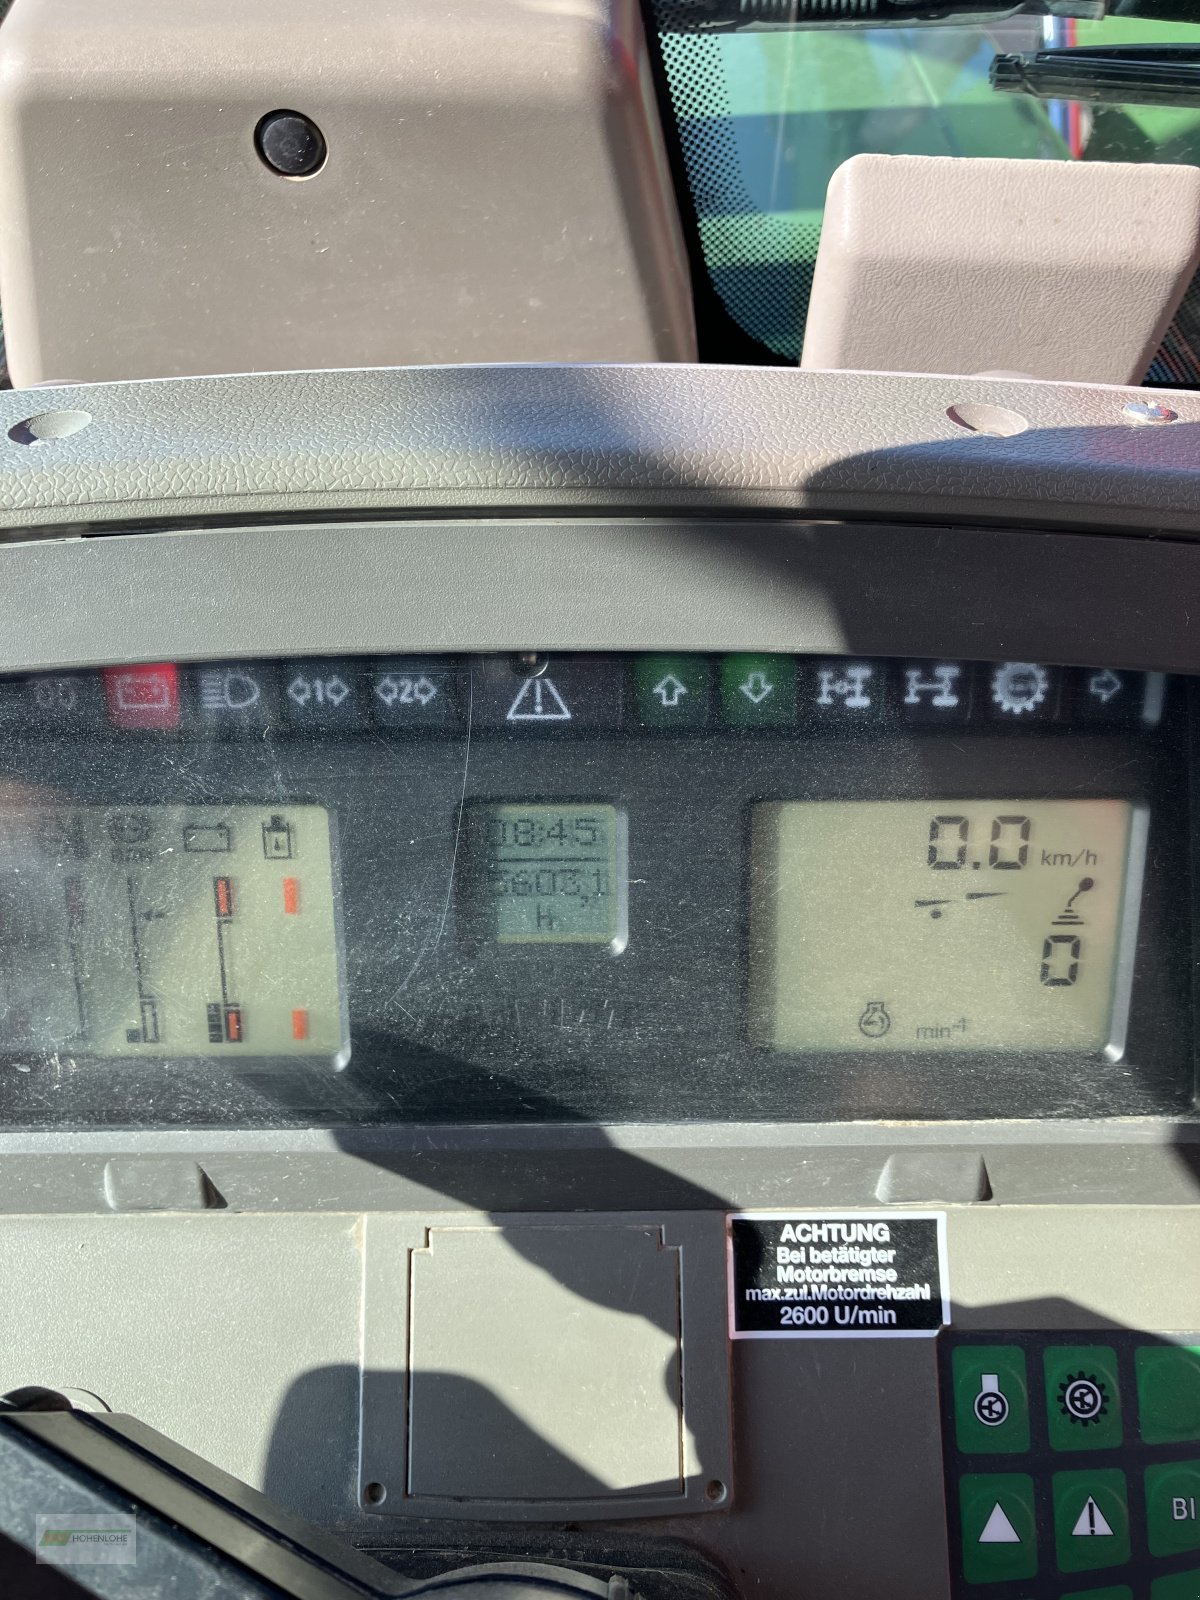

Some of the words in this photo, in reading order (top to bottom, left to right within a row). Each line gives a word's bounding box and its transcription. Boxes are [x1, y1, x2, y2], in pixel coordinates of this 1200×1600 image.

[927, 815, 1031, 870] 0.0
[1041, 849, 1097, 868] km/h
[1040, 934, 1080, 987] 0
[780, 1223, 890, 1243] ACHTUNG
[776, 1247, 806, 1264] Bei
[809, 1246, 896, 1267] betätigter
[776, 1265, 897, 1283] Motorbremse
[780, 1306, 829, 1325] 2600
[834, 1305, 897, 1325] U/min
